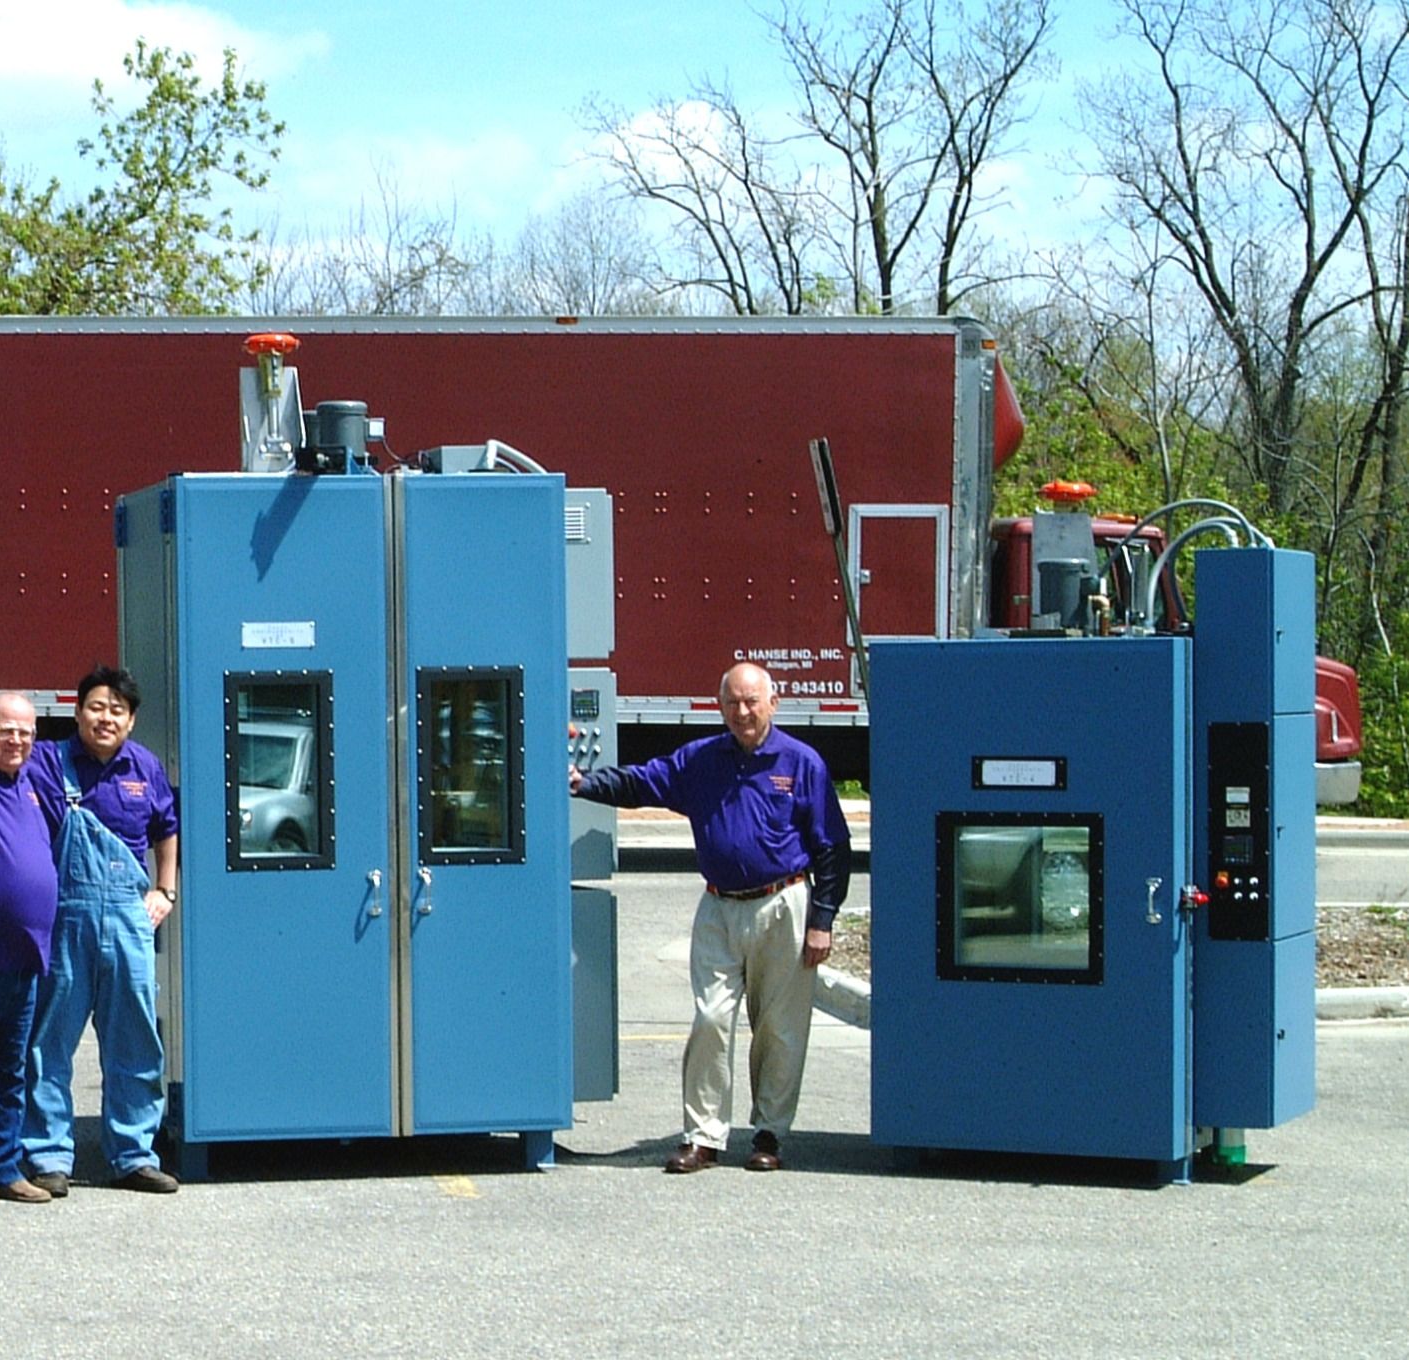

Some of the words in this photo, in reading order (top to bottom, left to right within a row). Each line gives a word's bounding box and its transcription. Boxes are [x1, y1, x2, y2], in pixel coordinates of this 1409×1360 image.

[734, 648, 746, 660] C.
[748, 648, 789, 660] HANSE
[820, 648, 844, 660] INC.
[791, 681, 844, 694] 943410
